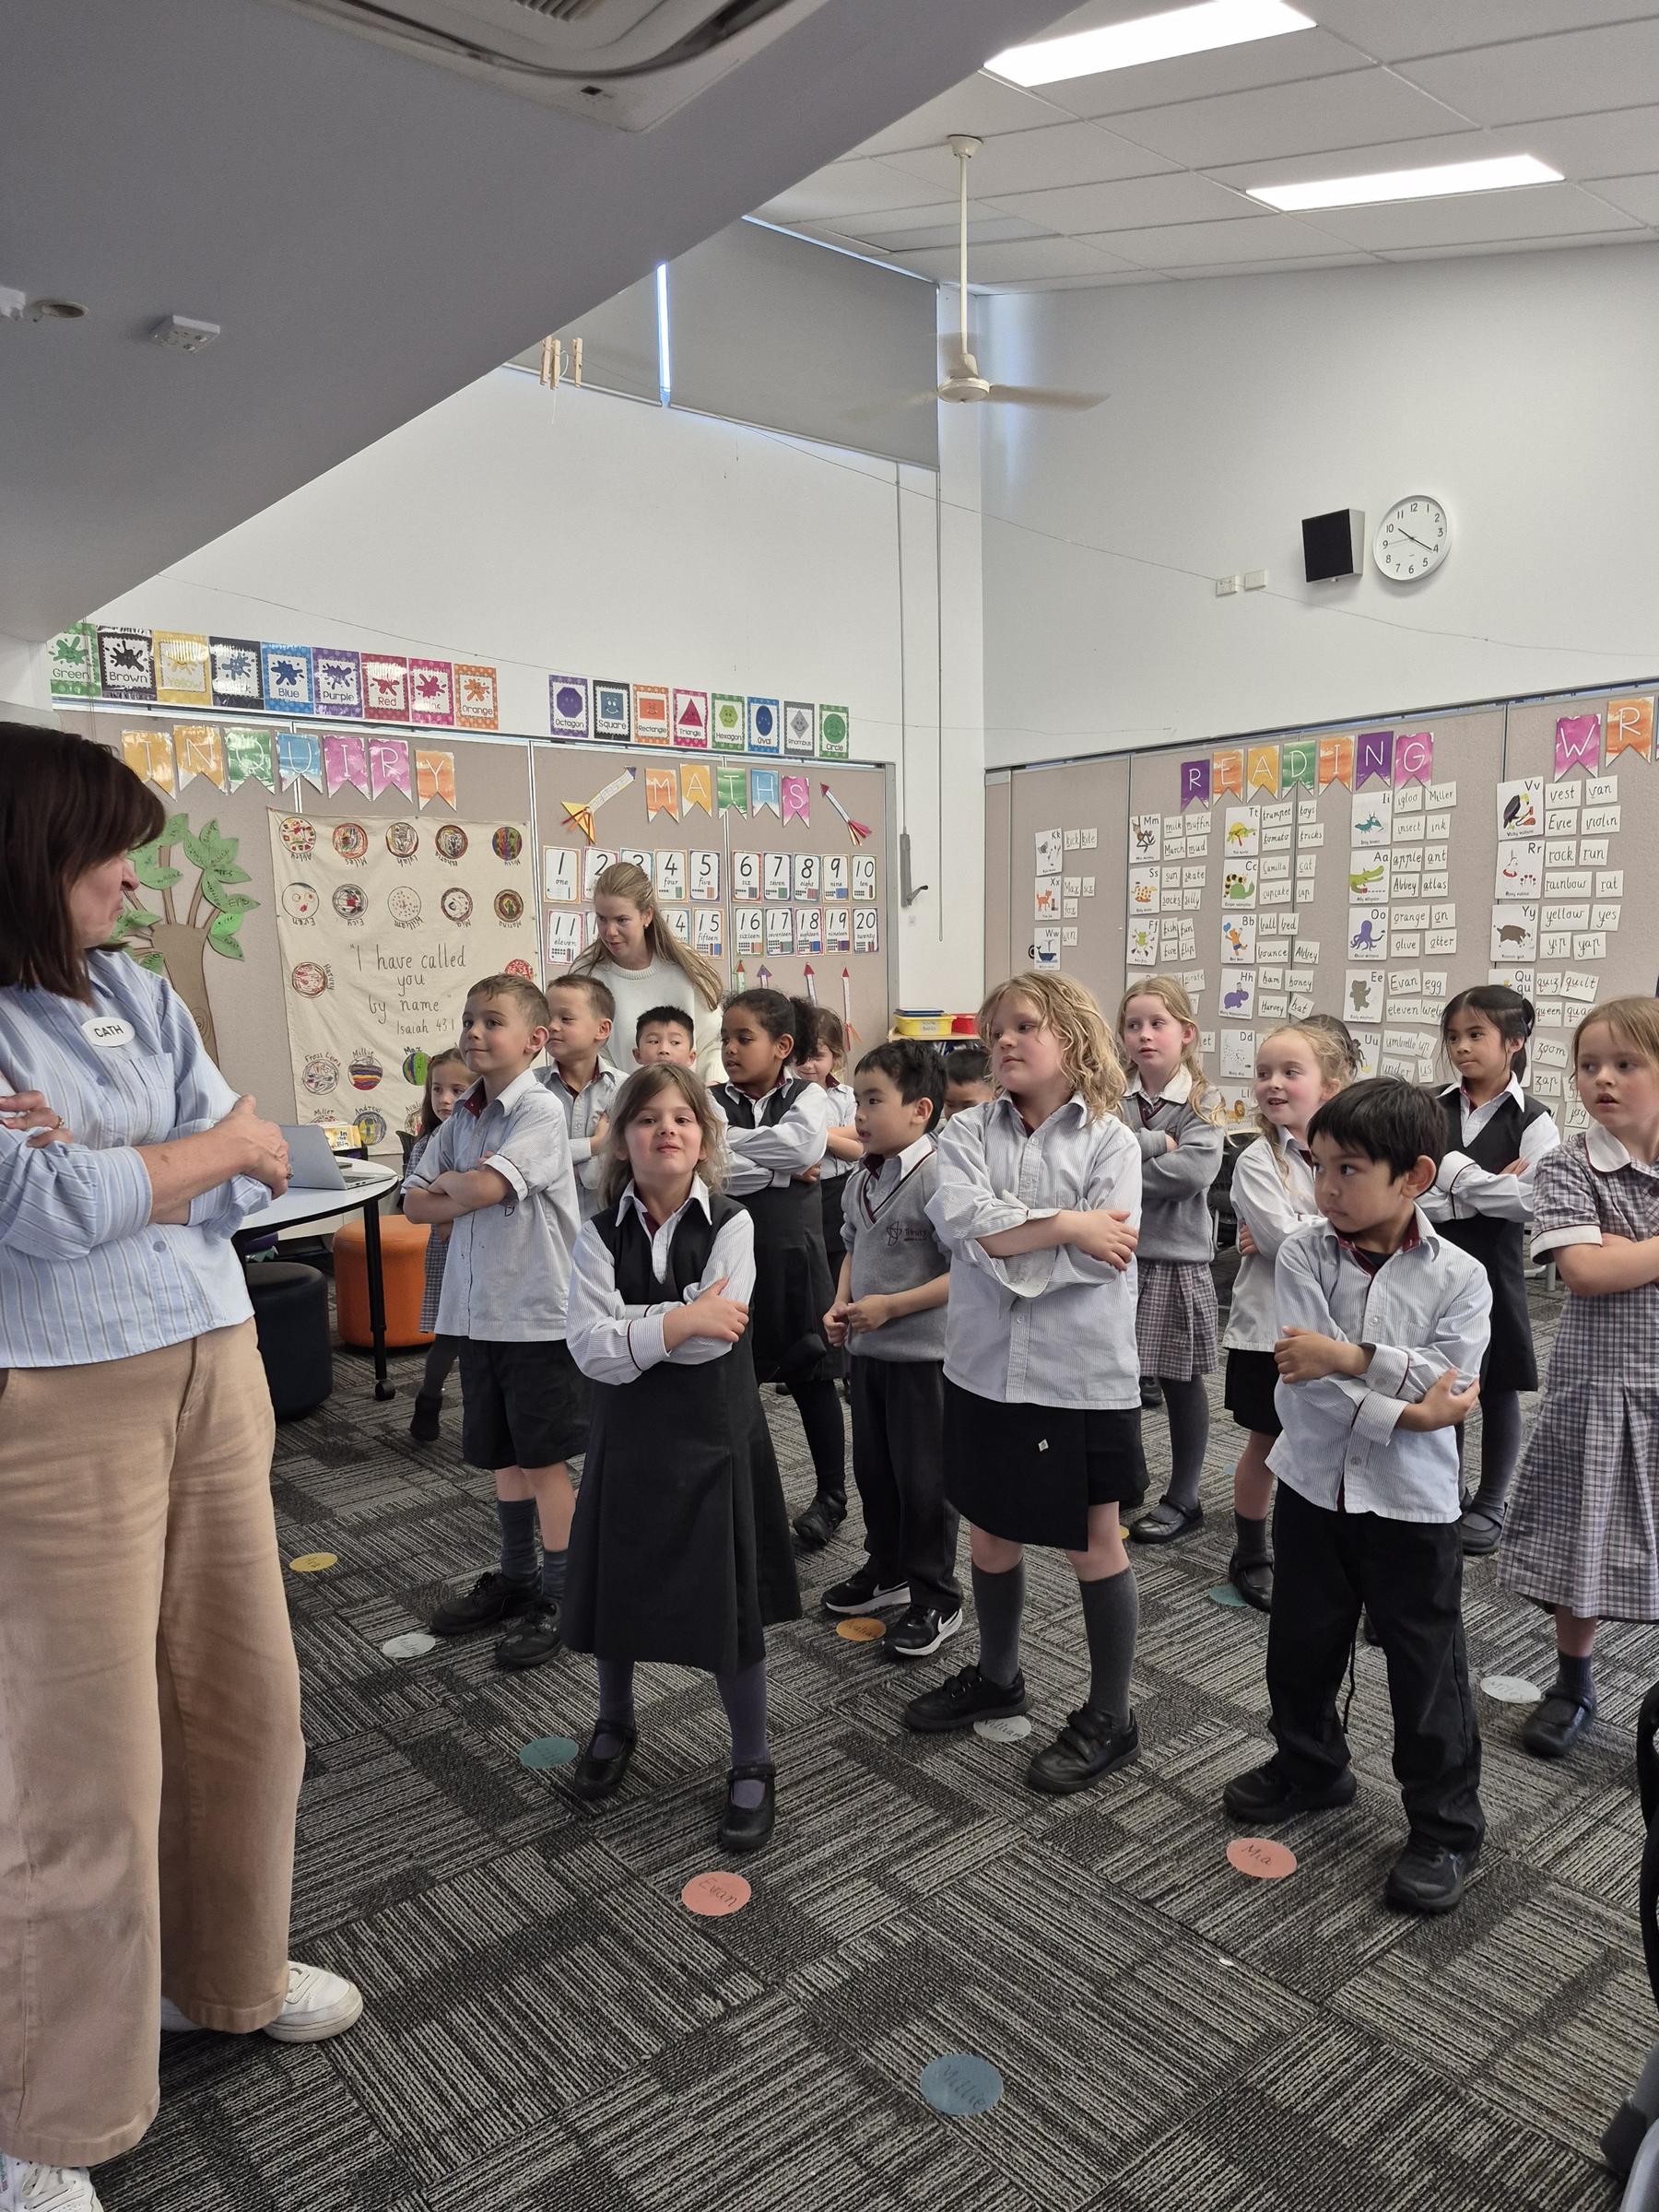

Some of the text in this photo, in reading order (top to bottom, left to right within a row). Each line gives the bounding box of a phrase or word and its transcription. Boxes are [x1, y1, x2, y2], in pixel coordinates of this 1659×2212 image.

[1410, 503, 1418, 512] 12
[1427, 504, 1430, 512] 1
[1435, 513, 1440, 523] 2
[1386, 524, 1394, 533] 10
[1438, 528, 1443, 536] 3
[1383, 540, 1388, 549] 9
[1433, 545, 1439, 553] 4
[1386, 555, 1391, 563] 8
[1423, 558, 1428, 567] 5
[1395, 563, 1401, 572] 7
[1409, 565, 1414, 574] 6
[53, 668, 90, 680] Green
[110, 671, 148, 683] Brown
[278, 688, 300, 698] Blue
[323, 691, 355, 702] Purple
[379, 697, 396, 706] Red
[463, 705, 493, 715] Orange
[556, 719, 584, 728] Octagon
[599, 720, 627, 729] Square
[679, 728, 701, 737] Triangle
[716, 732, 742, 741] Hexagon
[145, 738, 445, 790] INQUIRY
[1190, 741, 1426, 791] READING
[654, 774, 804, 809] MATHS
[1524, 780, 1540, 791] Vv
[1589, 785, 1611, 796] van
[1430, 791, 1453, 801] Miller
[1550, 785, 1574, 801] vest
[1398, 794, 1418, 809] igloo
[1249, 807, 1258, 817] Tt
[1264, 808, 1290, 821] trumpet
[1300, 806, 1314, 818] toys
[1144, 817, 1159, 825] Mm
[1166, 821, 1181, 830] milk
[1187, 816, 1209, 830] muffin
[1398, 822, 1420, 832] insect
[1431, 818, 1446, 832] ink
[1548, 814, 1571, 830] Evie
[1587, 814, 1617, 829] violin
[1052, 830, 1060, 839] Kk
[1265, 831, 1288, 842] tomato
[1300, 830, 1322, 841] tricks
[1165, 842, 1184, 854] March
[1189, 838, 1206, 852] mud
[1528, 842, 1541, 853] Rr
[1374, 852, 1388, 862] Aa
[1428, 850, 1446, 862] ant
[1549, 846, 1573, 862] rock
[1583, 849, 1604, 860] run
[346, 857, 367, 866] Miles
[559, 853, 564, 875] 1
[594, 853, 608, 876] 2
[665, 854, 677, 876] 4
[700, 854, 711, 876] 5
[740, 856, 751, 877] 6
[774, 856, 782, 877] 7
[1246, 861, 1257, 871] Cc
[1264, 862, 1286, 871] Camilla
[1300, 859, 1312, 870] cat
[1394, 852, 1421, 869] apple
[801, 858, 813, 878] 8
[831, 858, 840, 877] 9
[856, 861, 874, 877] 10
[1149, 868, 1158, 877] Ss
[1166, 871, 1178, 879] sun
[664, 877, 678, 887] four
[699, 877, 711, 886] five
[1394, 877, 1416, 895] Abbey
[1424, 877, 1446, 889] atlas
[1546, 877, 1586, 889] rainbow
[1602, 877, 1618, 889] rat
[1162, 894, 1181, 904] socks
[1185, 892, 1199, 908] silly
[1263, 888, 1289, 900] cupcake
[1299, 889, 1310, 900] cap
[1371, 909, 1385, 919] Oo
[1394, 912, 1425, 927] orange
[1435, 912, 1448, 921] on
[1523, 906, 1535, 921] Yy
[1546, 908, 1584, 927] yellow
[1596, 911, 1616, 927] yes
[394, 916, 423, 930] William
[556, 917, 575, 936] 11
[700, 914, 719, 932] 15
[741, 912, 759, 930] 16
[771, 912, 788, 930] 17
[801, 912, 818, 929] 18
[830, 912, 846, 929] 19
[856, 912, 875, 929] 20
[1242, 916, 1254, 925] Bb
[1282, 918, 1296, 930] bed
[1149, 921, 1158, 933] Ff
[1164, 922, 1176, 936] fish
[698, 933, 718, 941] fifteen
[1396, 938, 1416, 948] olive
[1430, 936, 1453, 947] otter
[1258, 947, 1288, 957] bounce
[1548, 938, 1566, 955] yip
[1578, 938, 1600, 957] yap
[376, 944, 412, 970] have
[421, 944, 466, 969] called
[1296, 947, 1317, 964] Abbey
[324, 964, 335, 990] Harvey
[1241, 971, 1253, 982] Hh
[1263, 971, 1279, 982] ham
[1371, 972, 1382, 982] Ee
[1391, 975, 1417, 990] Evan
[1515, 971, 1531, 982] Qu
[397, 974, 425, 996] you
[1425, 980, 1441, 994] egg
[1537, 978, 1558, 993] quiz
[1567, 977, 1596, 992] quilt
[369, 994, 386, 1024] by
[1262, 1001, 1284, 1017] Harvey
[1388, 1006, 1418, 1016] eleven
[1535, 1006, 1560, 1022] queen
[94, 1025, 124, 1037] CATH
[397, 1019, 428, 1034] Isaiah
[1241, 1032, 1253, 1041] Dd
[1365, 1034, 1378, 1045] Uu
[1535, 1042, 1565, 1060] zoom
[1420, 1065, 1431, 1074] us
[1535, 1076, 1558, 1092] zap
[355, 1104, 382, 1115] Andrew
[1567, 1108, 1586, 1124] jog
[1241, 1845, 1272, 1865] Mia
[699, 1877, 737, 1907] Evan
